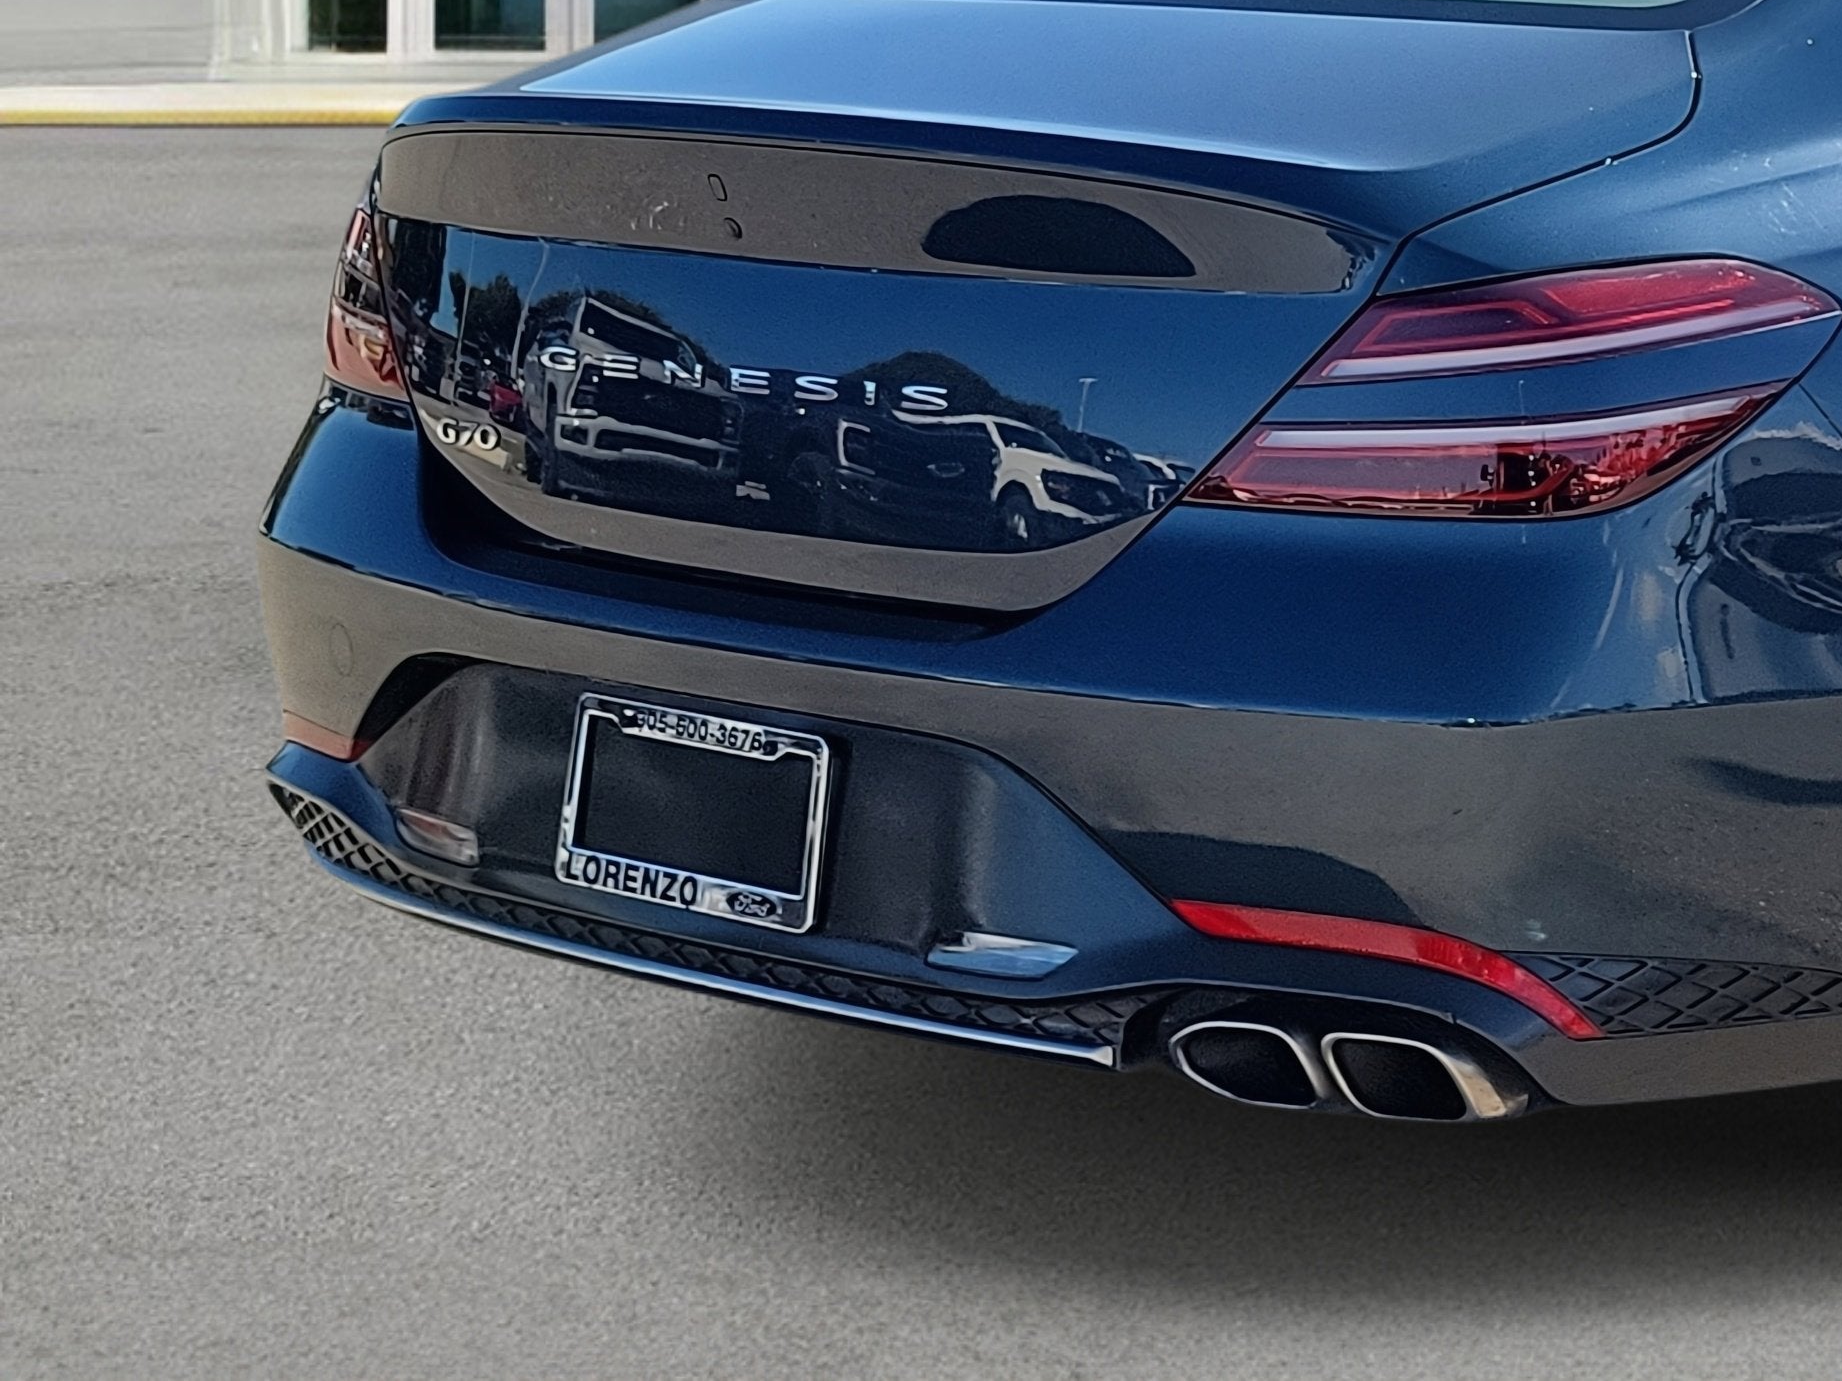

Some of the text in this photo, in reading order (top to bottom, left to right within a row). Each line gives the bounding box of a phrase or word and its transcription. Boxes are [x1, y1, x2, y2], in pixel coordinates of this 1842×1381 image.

[539, 346, 948, 411] GENESIS
[436, 417, 501, 451] G70
[564, 851, 699, 907] LORENZO
